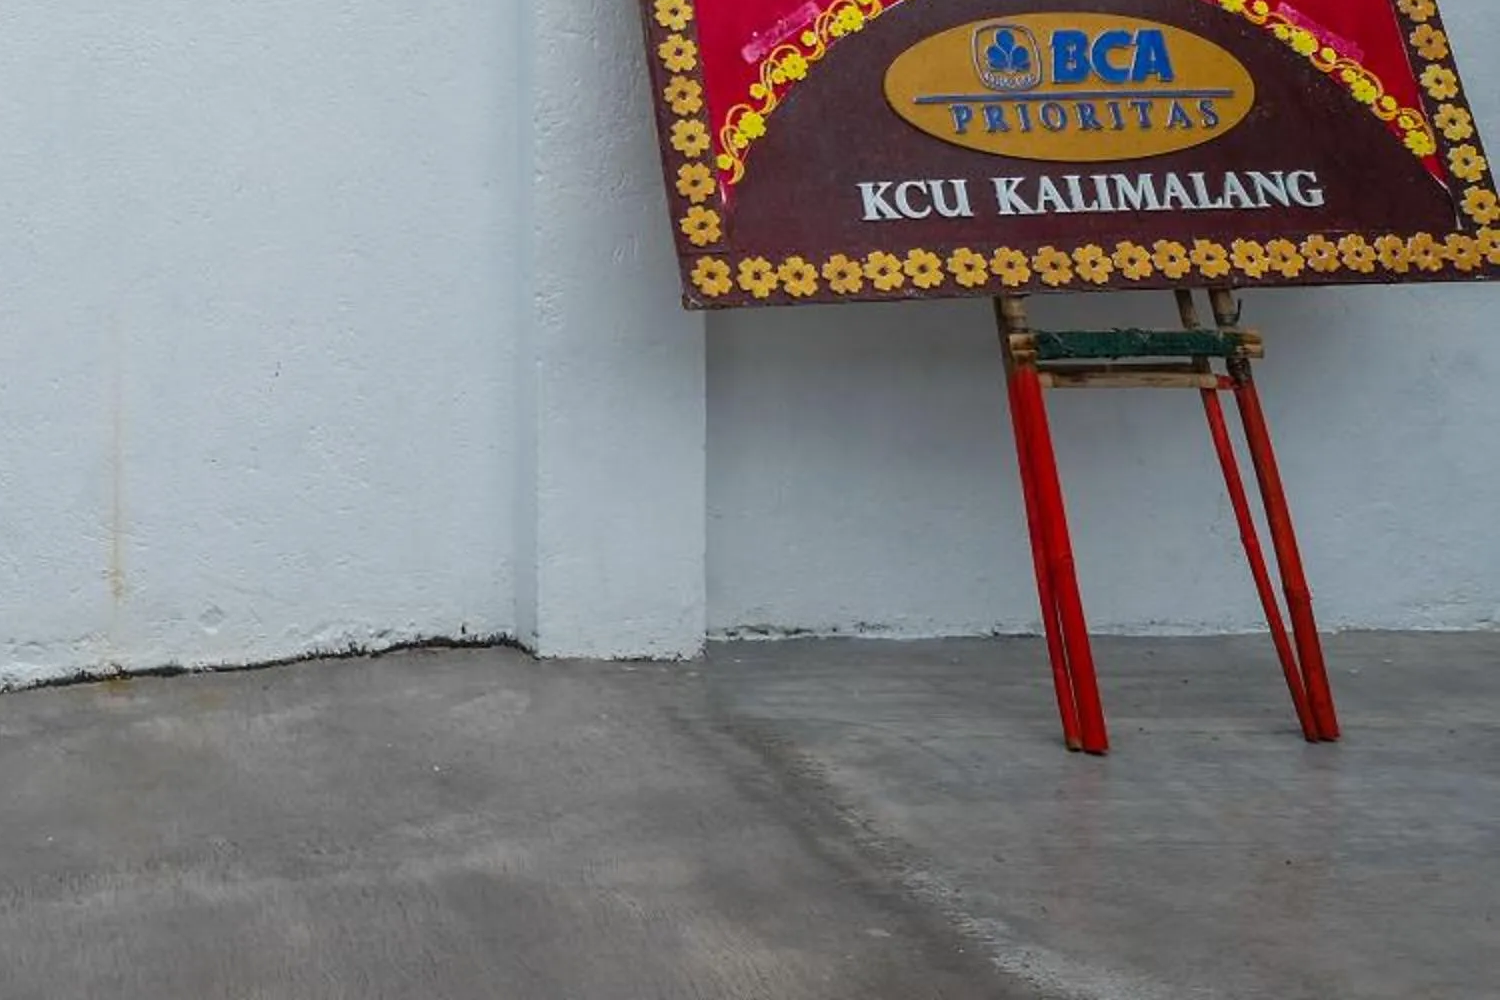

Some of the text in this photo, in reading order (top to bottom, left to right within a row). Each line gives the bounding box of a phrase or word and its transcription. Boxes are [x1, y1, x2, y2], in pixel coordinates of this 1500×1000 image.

[1051, 28, 1175, 83] BCA
[948, 98, 1220, 133] PRIORITAS
[855, 169, 1324, 221] KCU KALIMALANG
